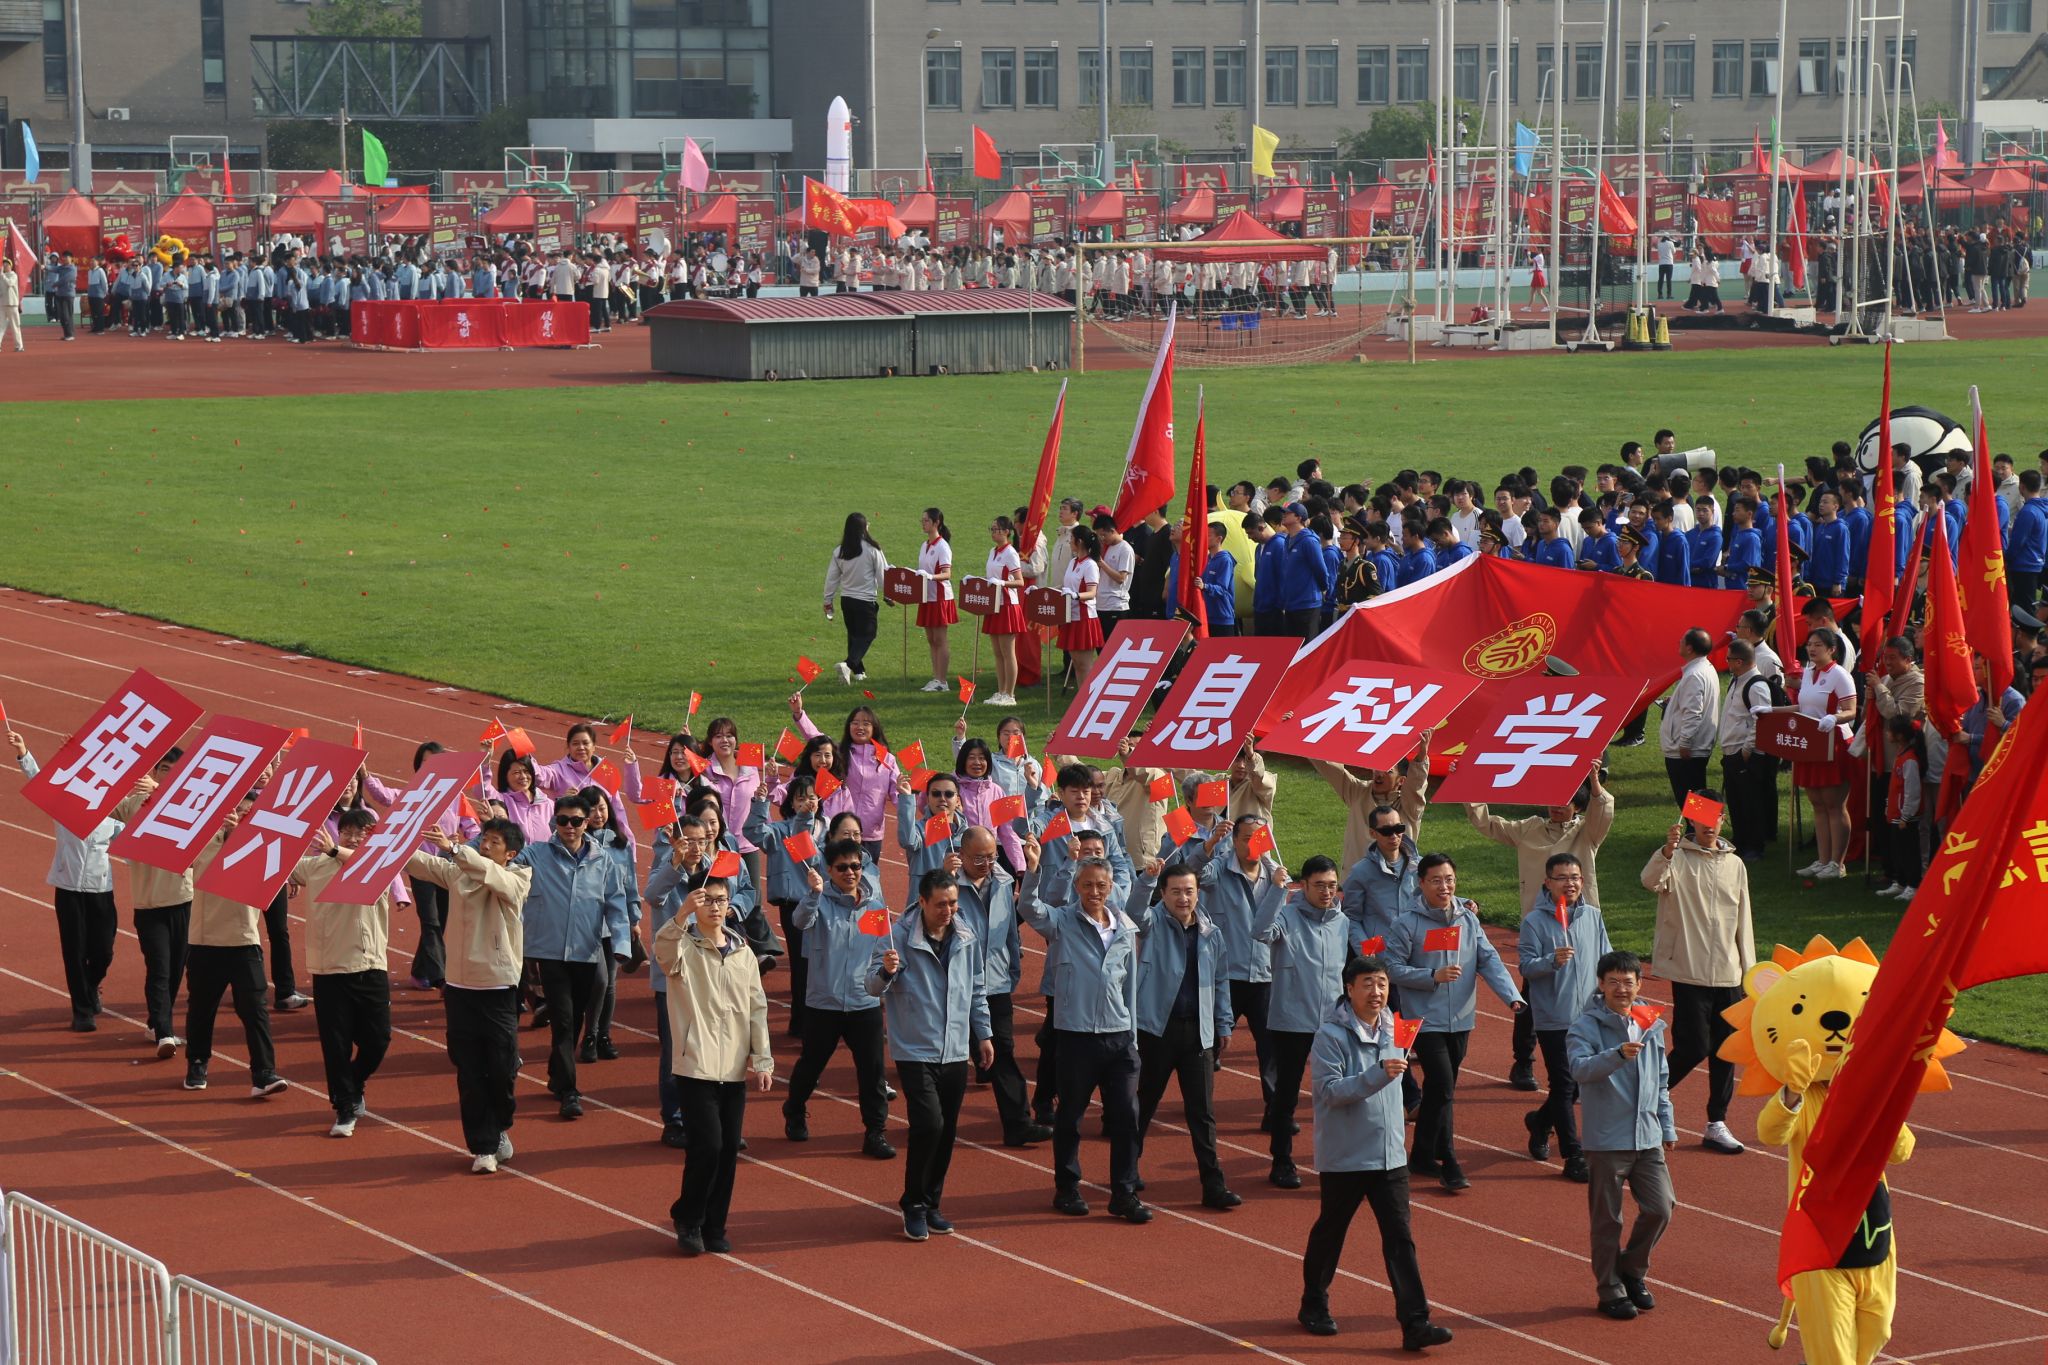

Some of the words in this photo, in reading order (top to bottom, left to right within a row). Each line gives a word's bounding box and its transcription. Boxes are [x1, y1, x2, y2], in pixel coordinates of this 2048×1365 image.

[1067, 637, 1164, 741] 信
[1152, 654, 1260, 751] 息
[1300, 677, 1443, 754] 科
[1474, 692, 1606, 788] 学
[48, 690, 172, 810] 强
[132, 735, 264, 850] 国
[1776, 733, 1809, 750] 机关工会
[222, 765, 334, 881] 兴
[341, 772, 458, 884] 邦
